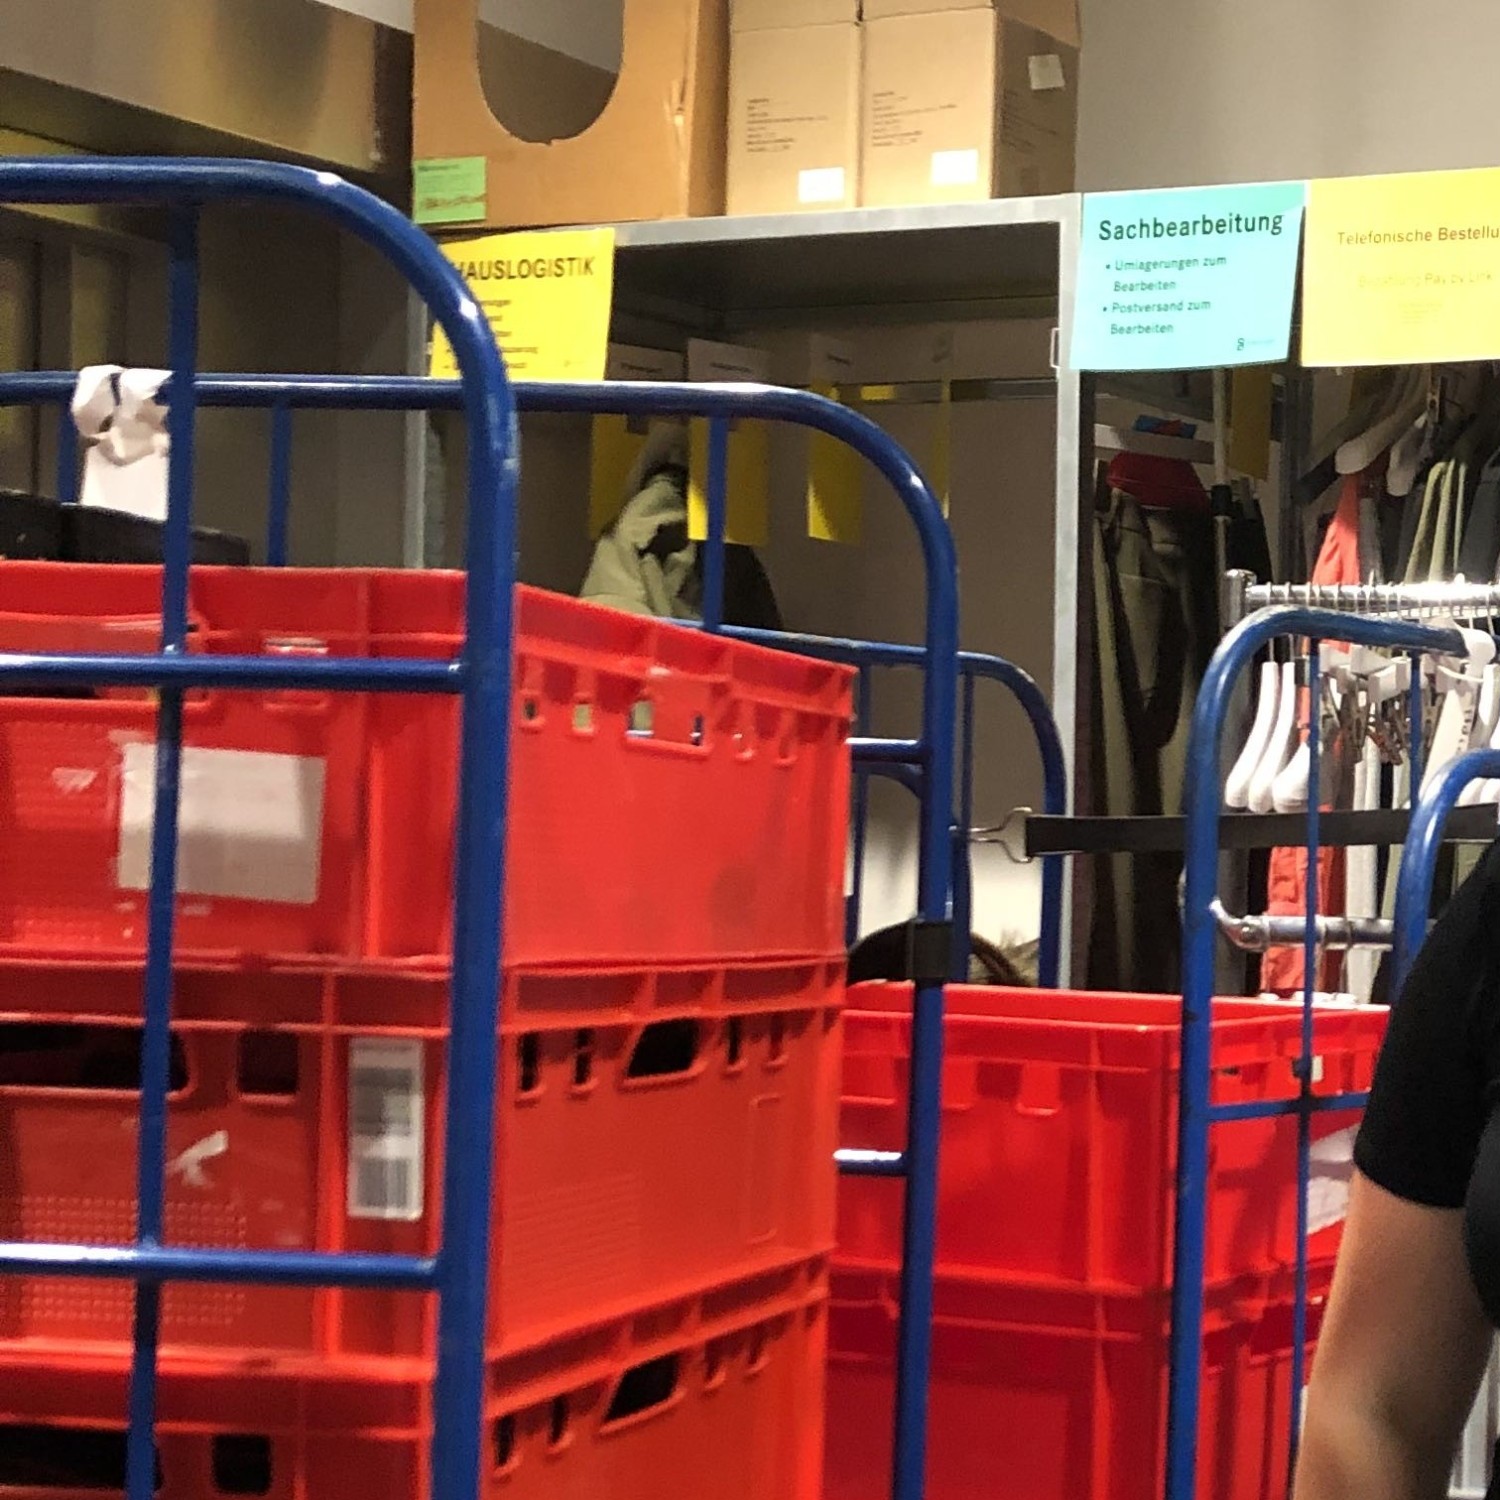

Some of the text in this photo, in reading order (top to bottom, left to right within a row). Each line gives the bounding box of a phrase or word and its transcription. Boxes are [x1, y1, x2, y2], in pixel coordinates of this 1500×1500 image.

[1099, 212, 1284, 241] Sachbearbeitung
[1337, 229, 1433, 247] Telefonische
[1115, 256, 1227, 272] Umlagerungen zum
[1113, 280, 1177, 292] Bearbeiten
[1112, 301, 1211, 313] Postversand zum
[1110, 323, 1174, 335] Bearbeiten
